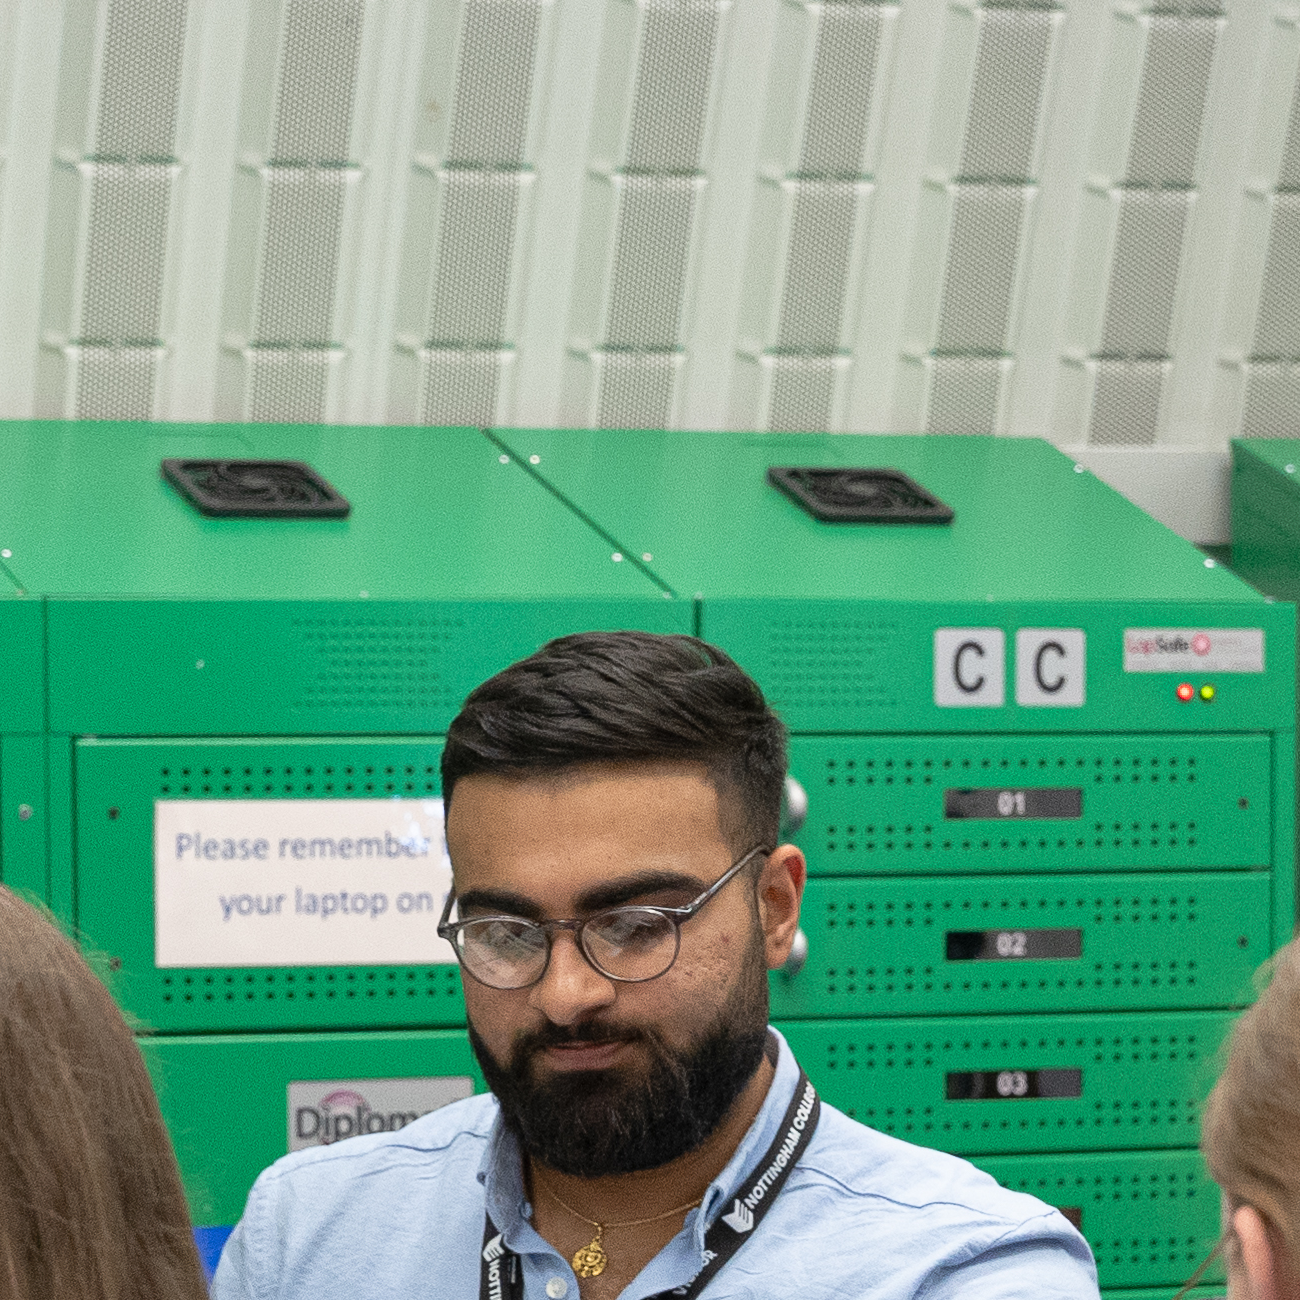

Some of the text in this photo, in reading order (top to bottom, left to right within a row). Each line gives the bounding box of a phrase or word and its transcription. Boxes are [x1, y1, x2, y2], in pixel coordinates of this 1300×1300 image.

[952, 641, 1067, 694] C C
[997, 791, 1026, 816] 01
[175, 833, 270, 861] Please
[278, 831, 430, 861] remember
[219, 893, 285, 921] your
[295, 887, 389, 920] laptop
[396, 892, 433, 914] on
[996, 932, 1027, 957] 02
[997, 1071, 1028, 1096] 03
[745, 1126, 800, 1210] NOTTINGHAM
